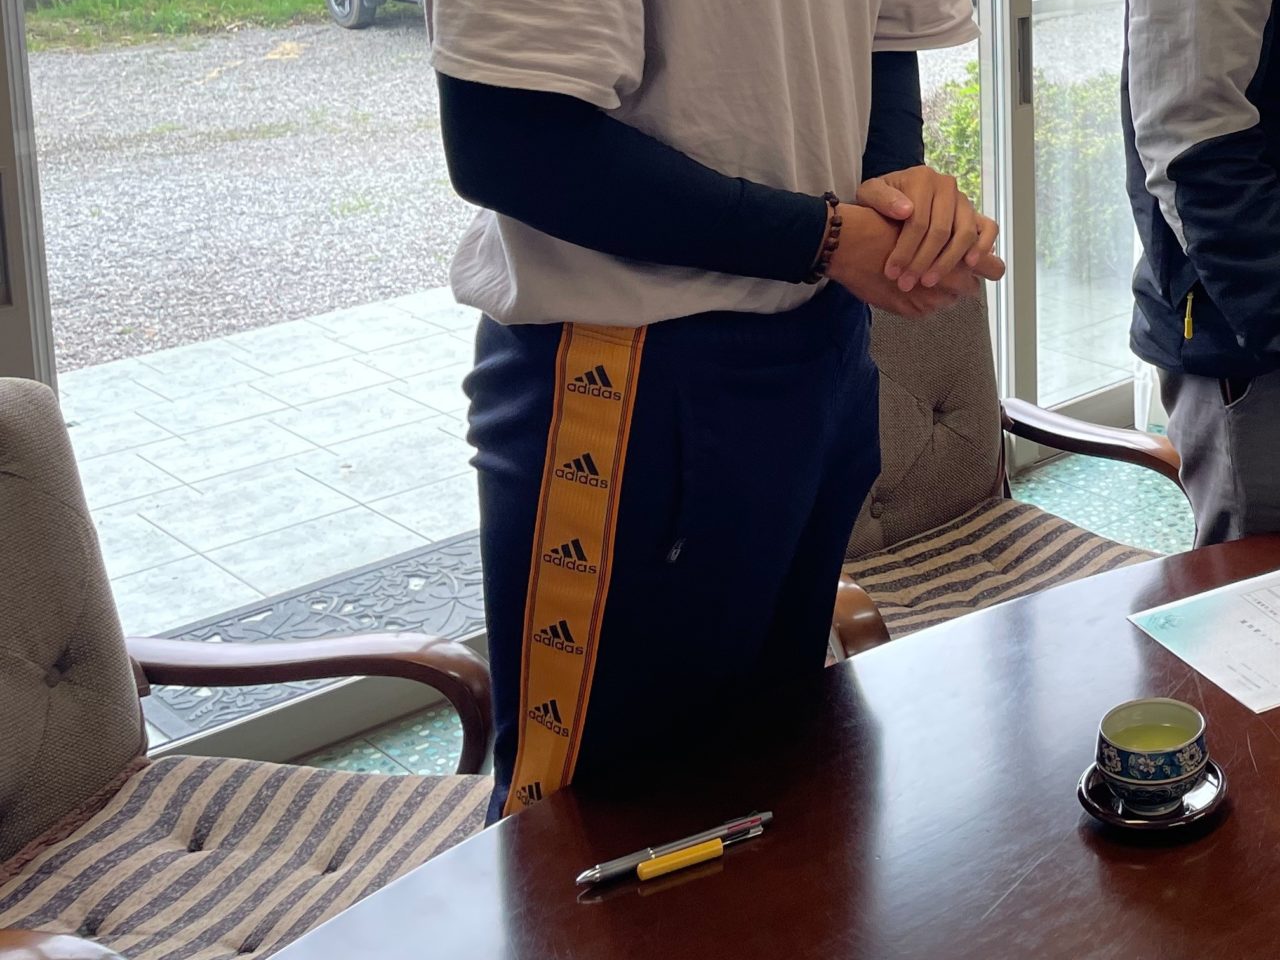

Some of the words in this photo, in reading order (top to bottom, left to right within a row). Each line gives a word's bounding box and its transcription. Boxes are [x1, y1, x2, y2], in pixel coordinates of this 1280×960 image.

[567, 382, 621, 401] adidas
[555, 468, 608, 489] adidas
[543, 553, 597, 574] adidas
[533, 632, 584, 655] adidas
[528, 709, 569, 738] adidas
